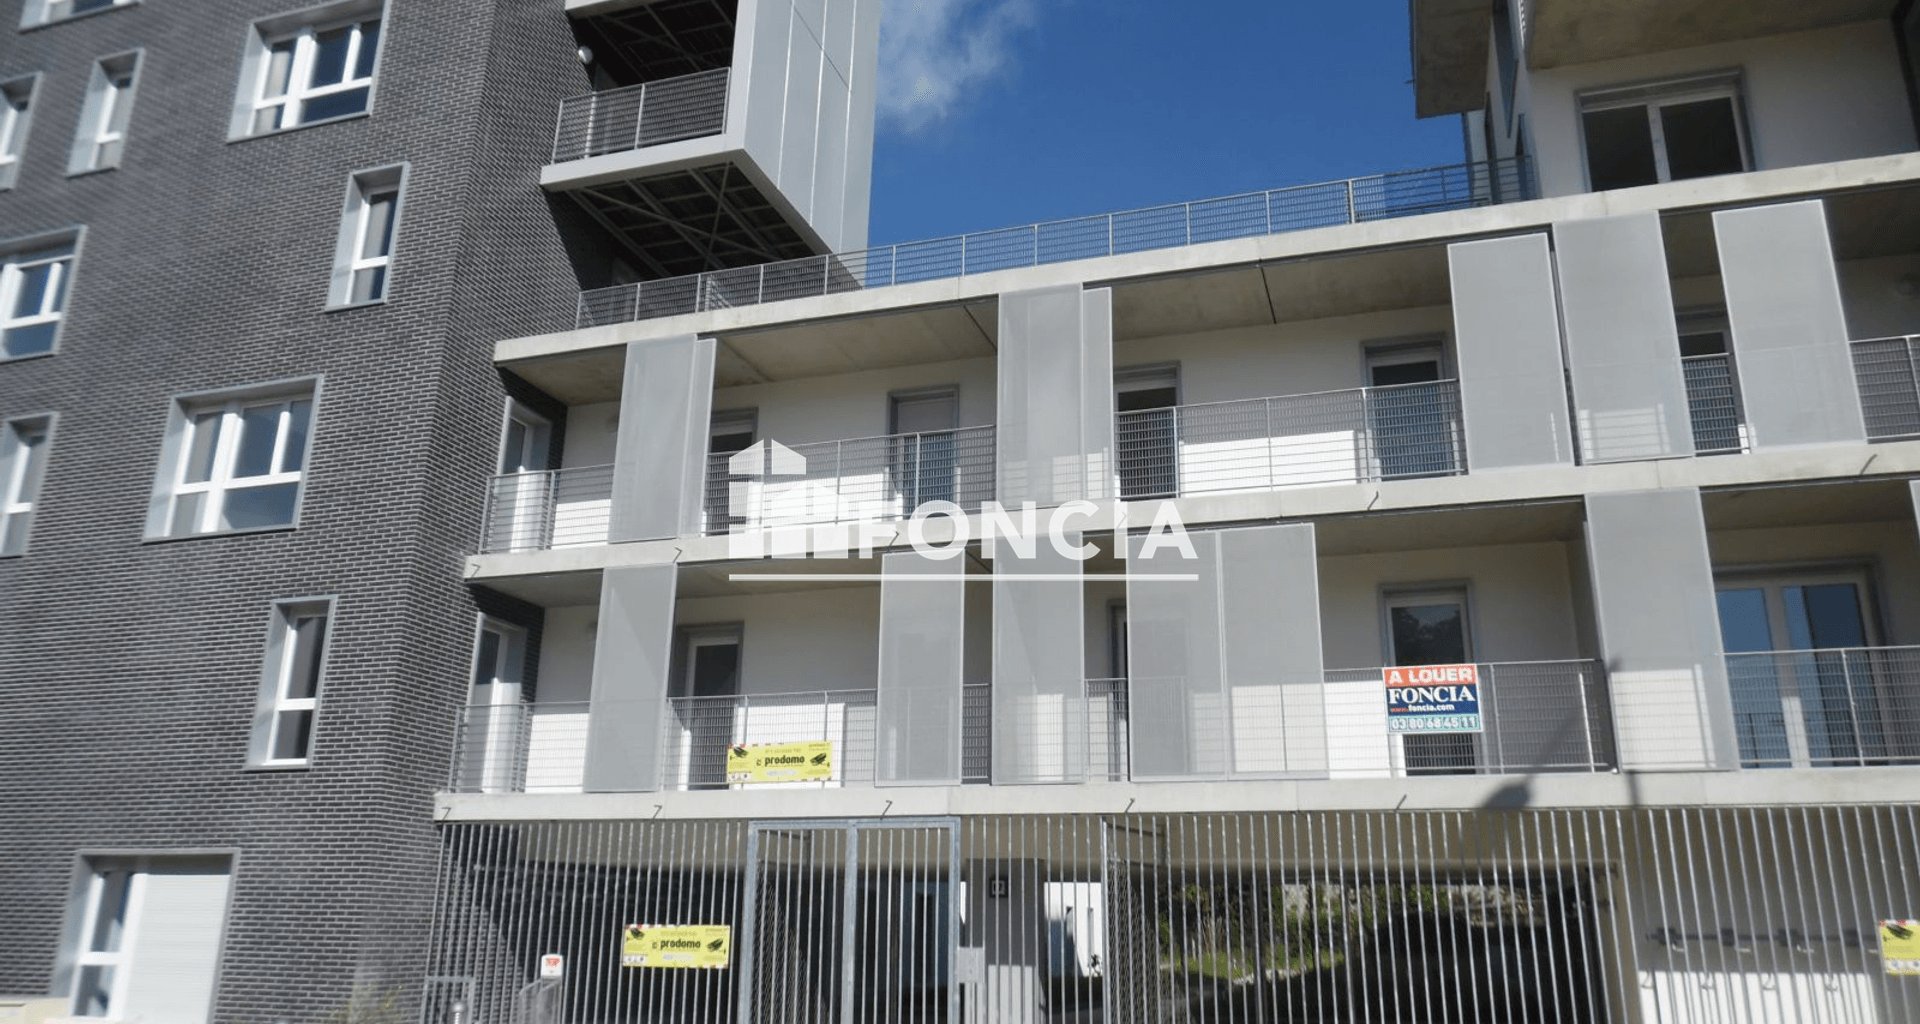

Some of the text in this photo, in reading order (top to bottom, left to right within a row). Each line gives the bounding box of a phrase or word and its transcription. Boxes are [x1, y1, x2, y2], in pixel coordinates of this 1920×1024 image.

[1389, 667, 1473, 684] A LOUER
[1388, 685, 1476, 704] FONCIA
[1391, 718, 1407, 730] 03
[1461, 716, 1476, 728] 11
[764, 754, 805, 767] prodomo
[660, 938, 701, 951] prodomo
